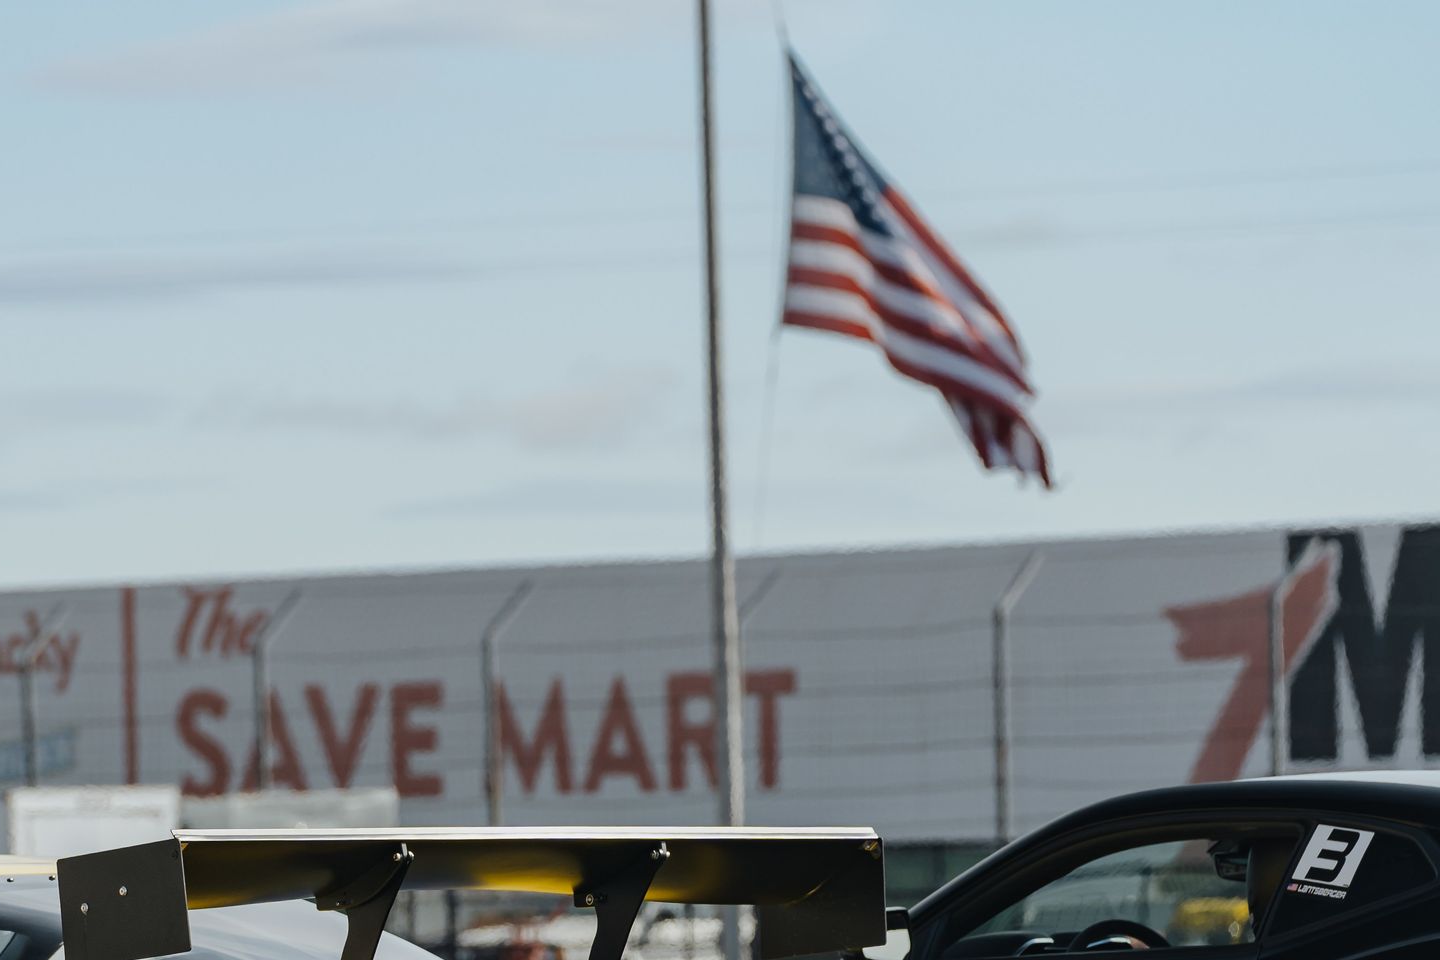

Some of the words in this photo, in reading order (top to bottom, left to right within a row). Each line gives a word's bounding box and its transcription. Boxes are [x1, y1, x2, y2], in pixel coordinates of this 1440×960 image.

[176, 583, 271, 658] The
[174, 680, 446, 797] SAVE
[494, 666, 798, 795] MART
[1305, 828, 1361, 882] 3
